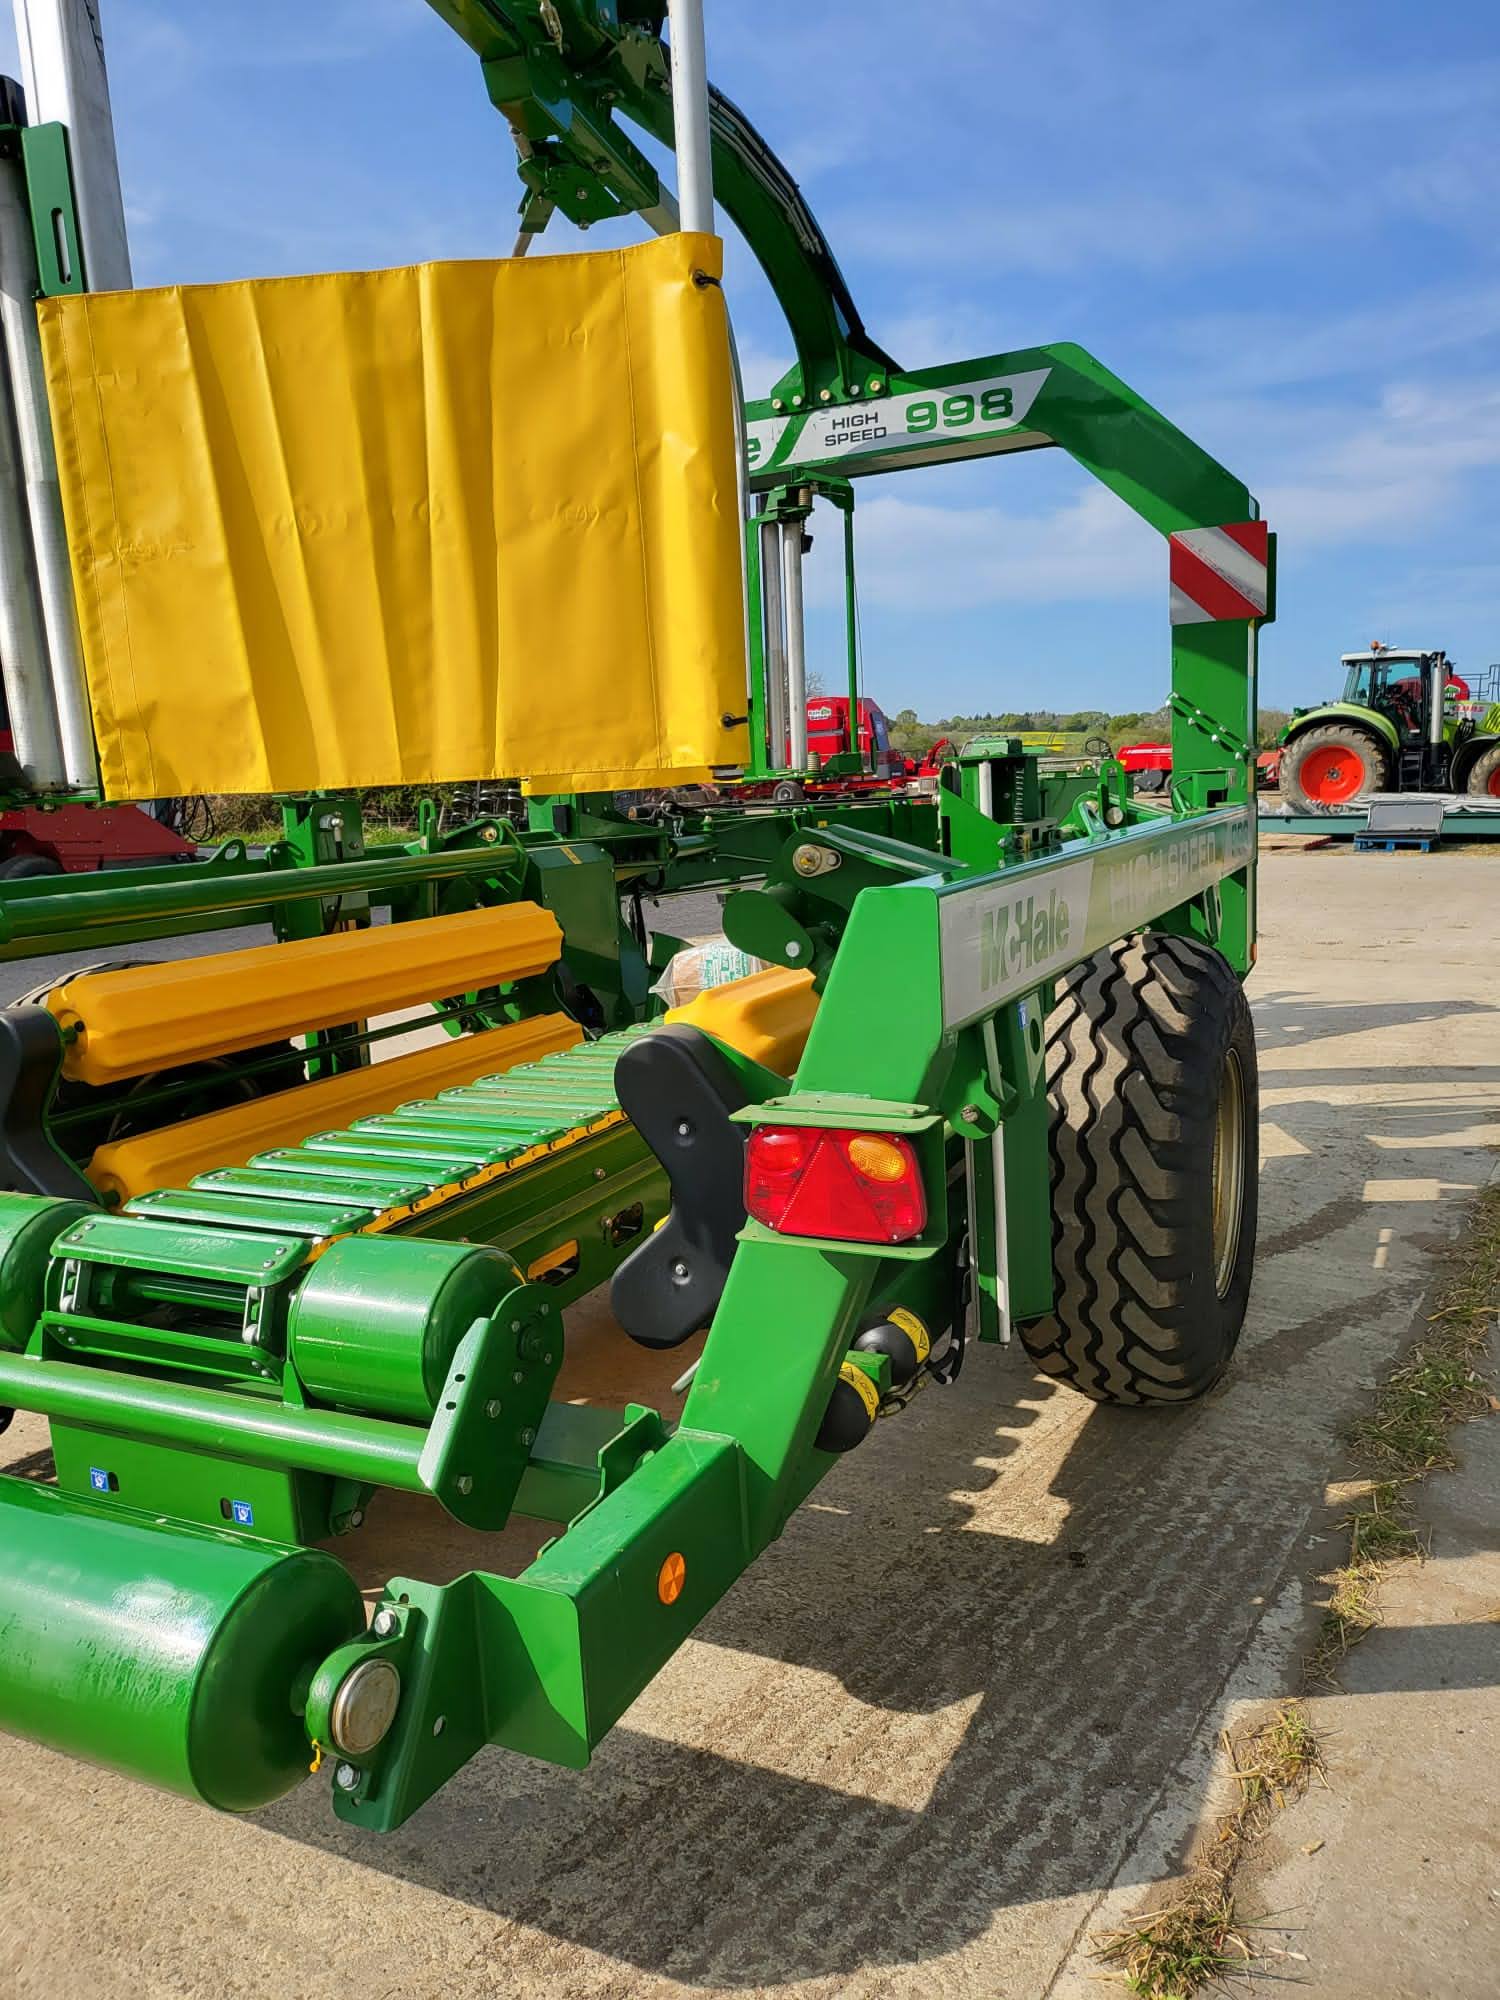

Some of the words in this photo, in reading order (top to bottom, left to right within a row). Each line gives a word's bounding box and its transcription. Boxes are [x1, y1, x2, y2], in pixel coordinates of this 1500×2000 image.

[906, 387, 1013, 433] 998
[832, 411, 879, 431] HIGH
[824, 426, 887, 447] SPEED
